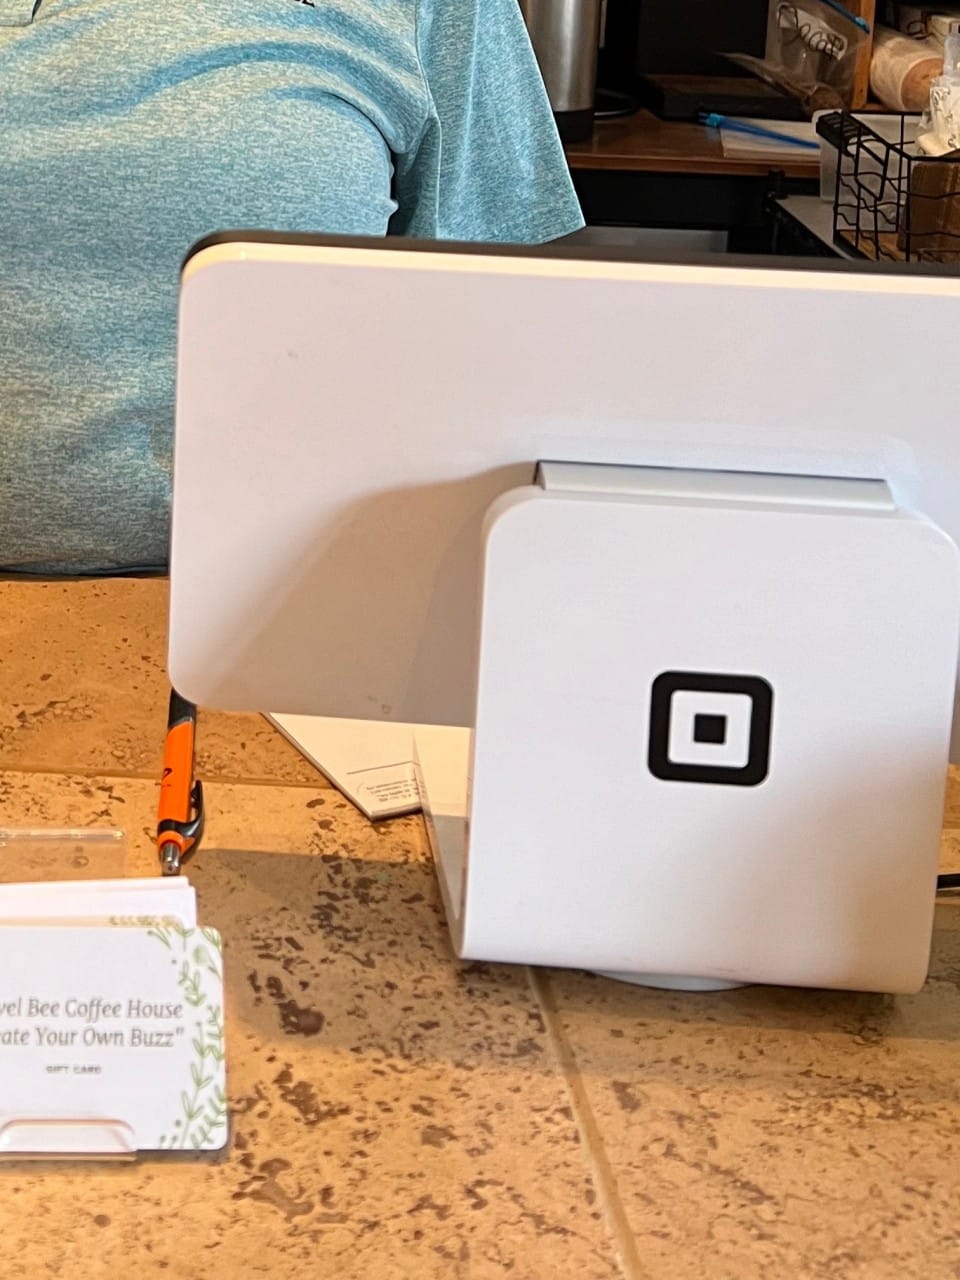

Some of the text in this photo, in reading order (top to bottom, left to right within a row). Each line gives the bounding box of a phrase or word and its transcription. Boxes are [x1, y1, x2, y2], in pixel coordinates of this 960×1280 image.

[27, 998, 61, 1018] Bee
[64, 998, 123, 1023] Coffee
[126, 999, 184, 1019] House
[35, 1027, 79, 1046] Your
[82, 1028, 125, 1047] Own
[129, 1027, 185, 1048] Buzz"
